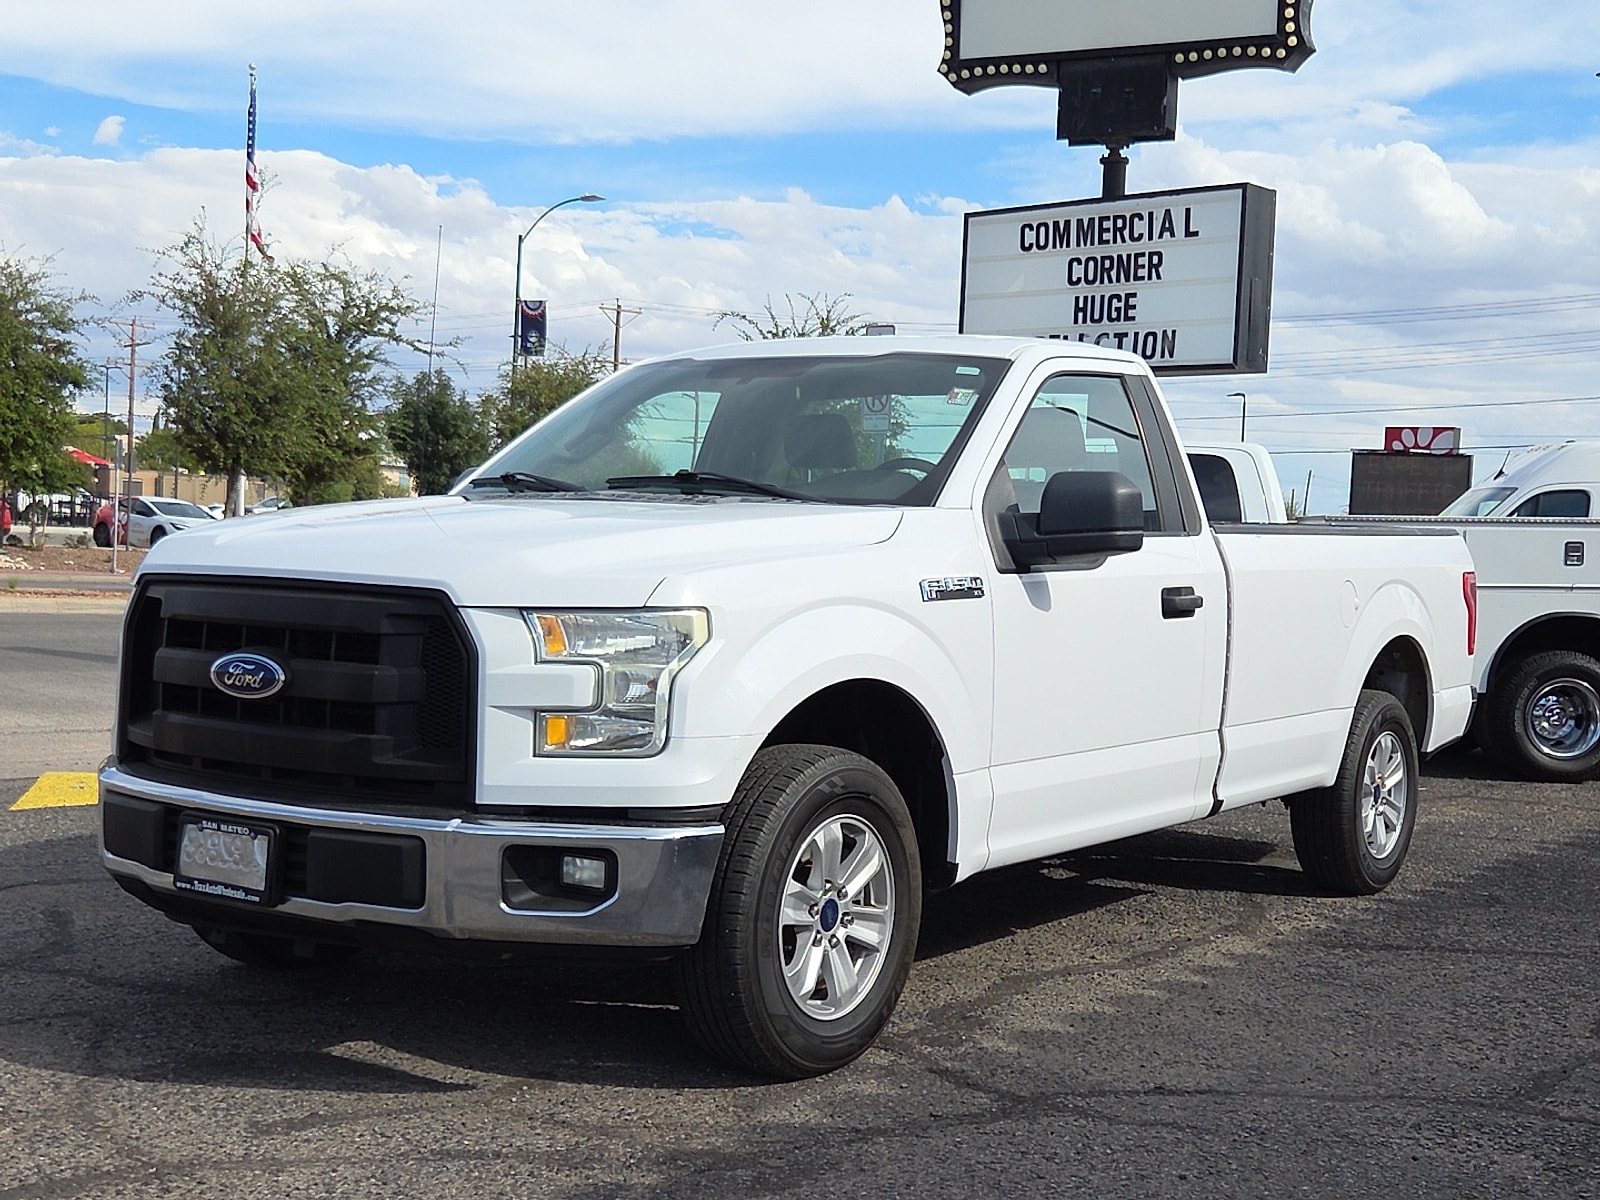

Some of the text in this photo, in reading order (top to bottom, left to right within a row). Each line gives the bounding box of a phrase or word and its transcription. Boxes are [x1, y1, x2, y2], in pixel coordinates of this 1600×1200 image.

[1020, 207, 1199, 252] COMMERCIAL
[1067, 251, 1163, 286] CORNER
[1073, 292, 1137, 325] HUGE
[224, 661, 265, 688] Ford
[202, 820, 250, 835] SAN MATEO
